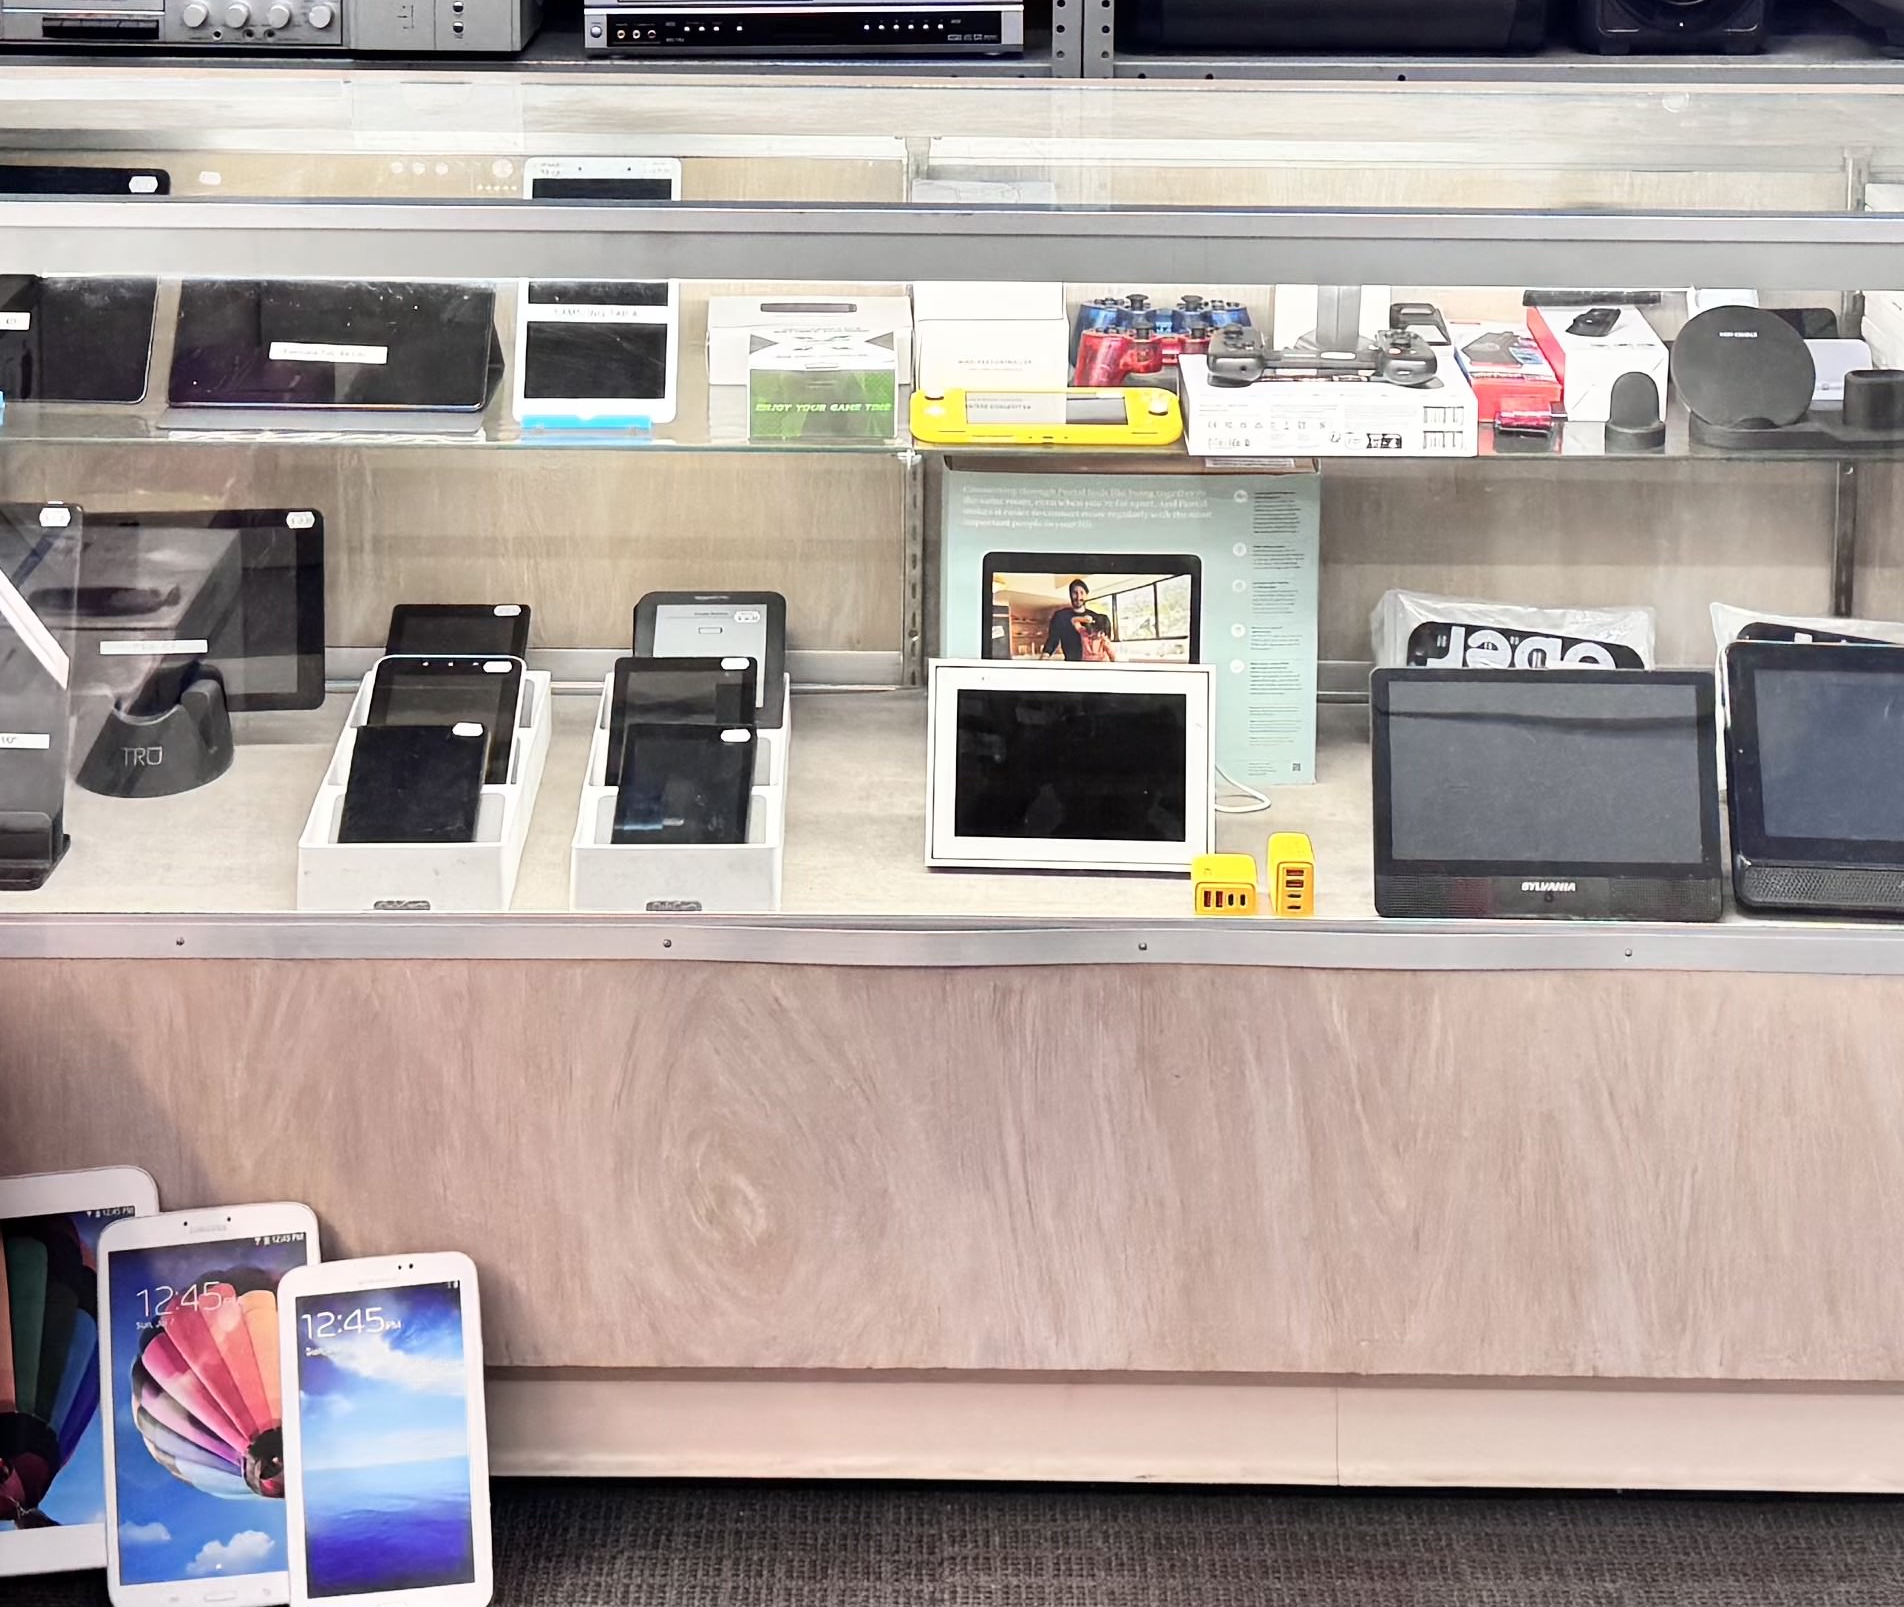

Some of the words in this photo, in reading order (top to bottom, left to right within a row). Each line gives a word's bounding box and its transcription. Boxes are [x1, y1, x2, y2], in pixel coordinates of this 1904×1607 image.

[795, 402, 826, 412] YOUR
[829, 402, 863, 412] GAME
[1521, 881, 1576, 892] SYLVANIA
[135, 1280, 223, 1319] 12:45
[301, 1306, 385, 1340] 12:45
